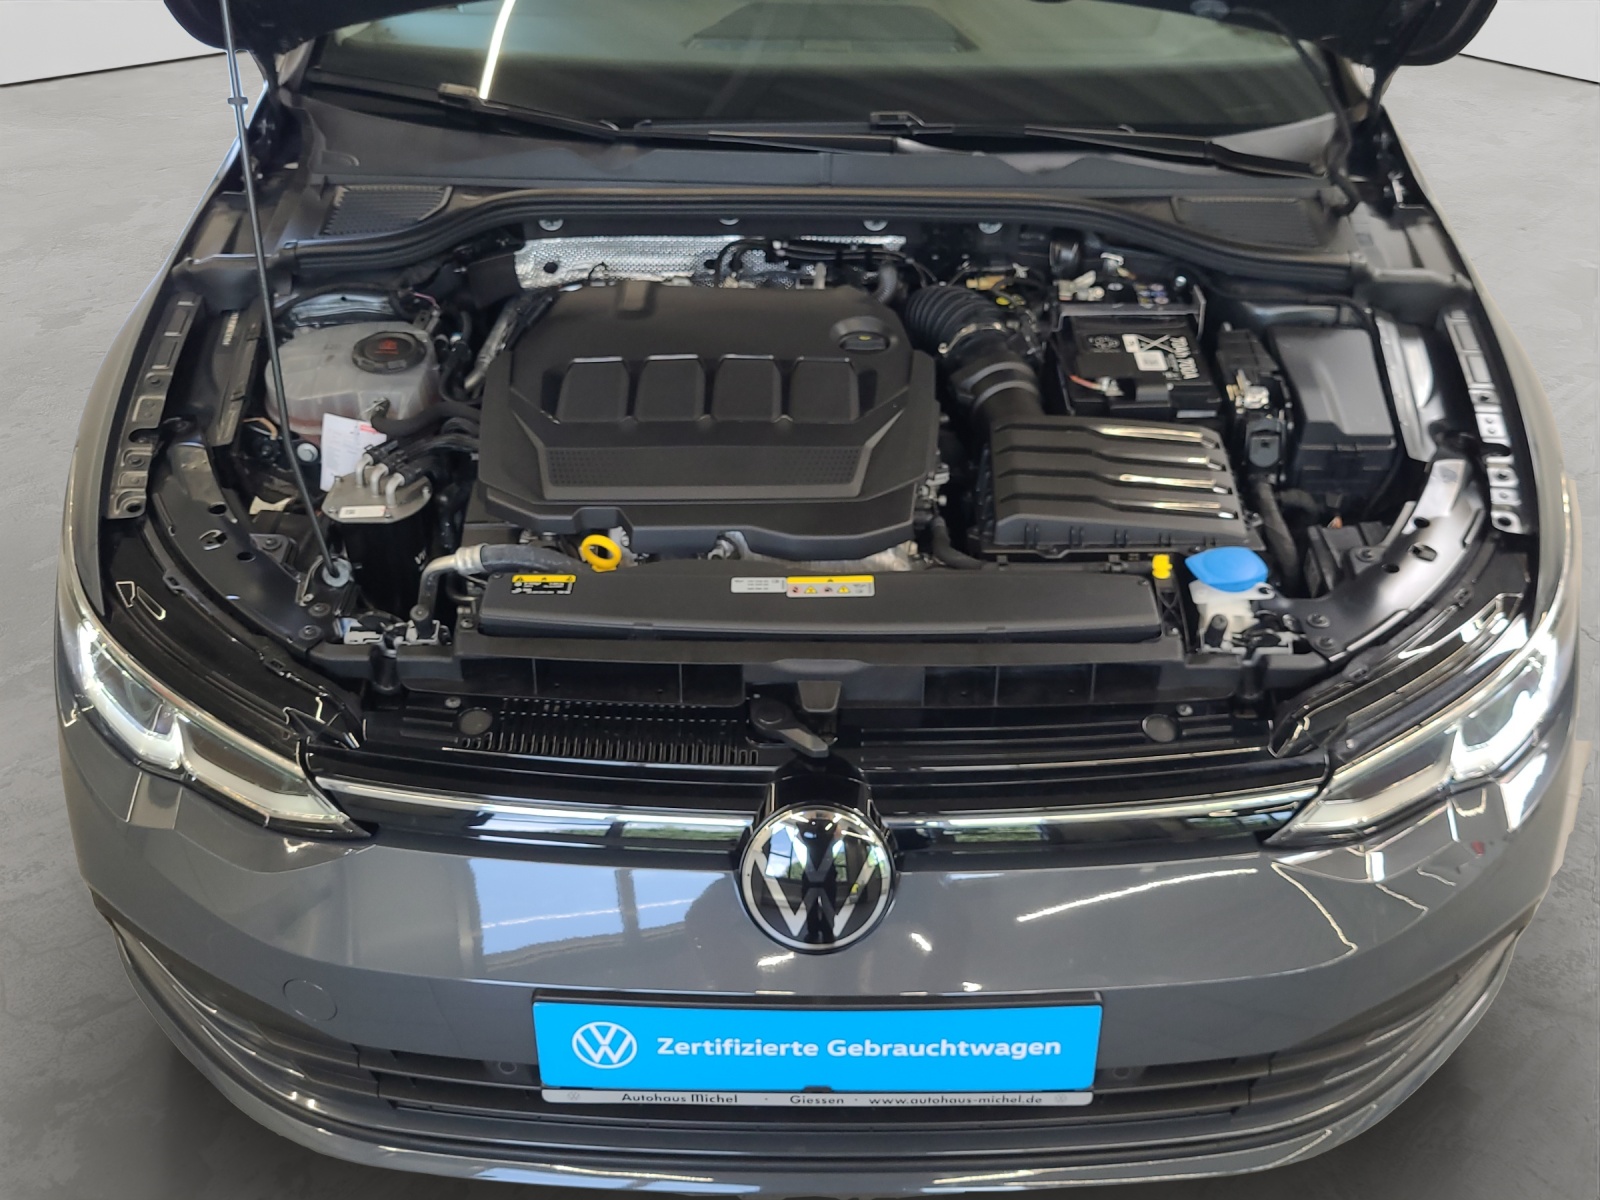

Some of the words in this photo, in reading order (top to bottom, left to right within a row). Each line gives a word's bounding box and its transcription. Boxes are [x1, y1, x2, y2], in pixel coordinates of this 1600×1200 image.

[657, 1037, 819, 1057] Zertifizierte
[827, 1039, 1062, 1060] Gebrauchtwagen
[621, 1093, 687, 1103] Autohaus
[690, 1093, 738, 1104] Michel
[789, 1095, 845, 1105] Giessen
[868, 1094, 1043, 1105] www.autohaus-michel.de
